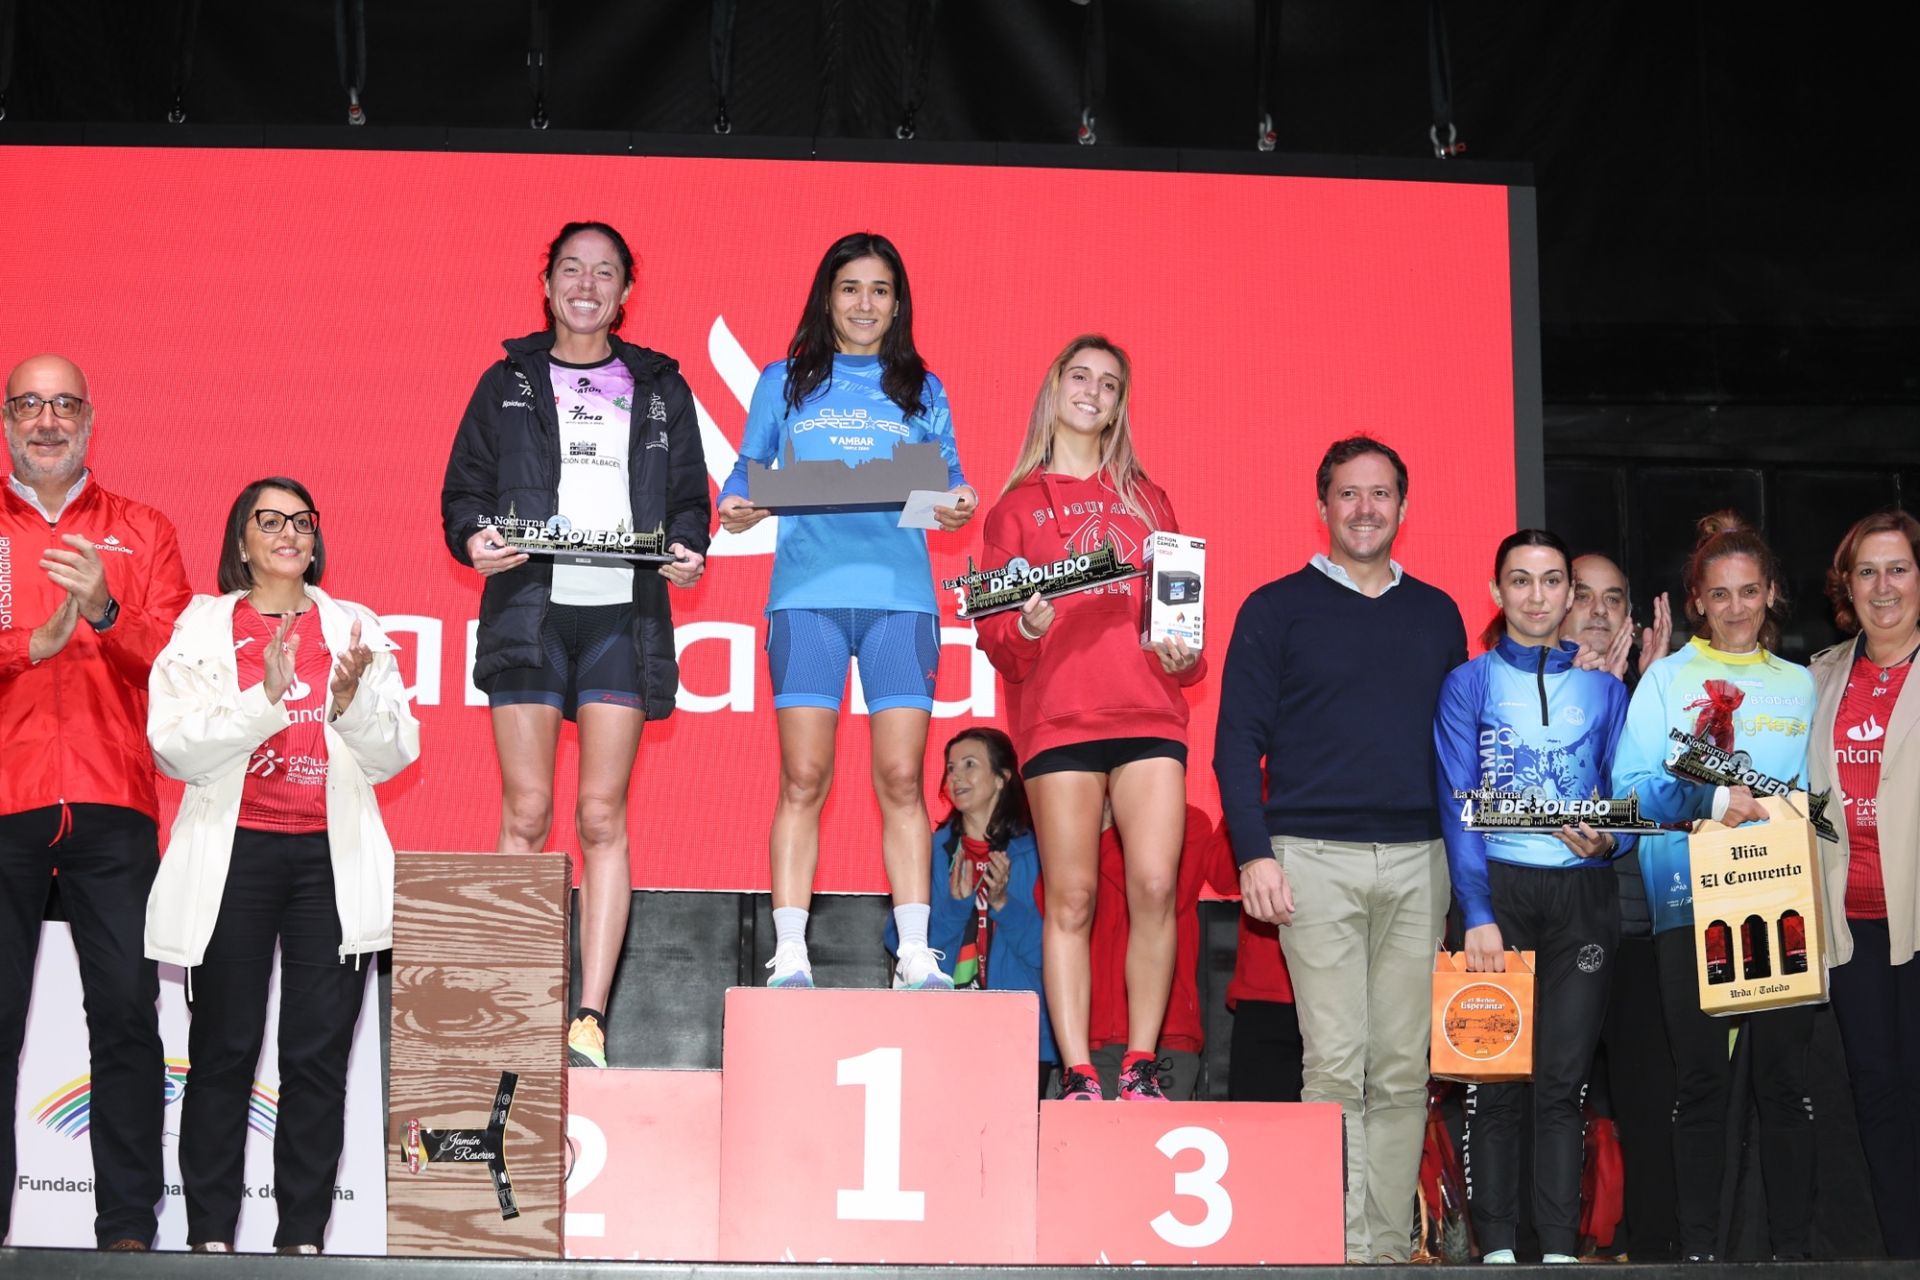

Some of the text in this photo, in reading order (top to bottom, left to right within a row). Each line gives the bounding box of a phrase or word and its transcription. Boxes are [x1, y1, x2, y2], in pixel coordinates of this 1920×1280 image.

[820, 408, 867, 419] CLUB
[838, 436, 875, 446] AMBAR
[477, 514, 545, 529] La Nocturna
[524, 528, 550, 542] DE
[1157, 535, 1177, 543] ACTION
[92, 542, 134, 555] antander
[1156, 540, 1179, 549] CAMERA
[943, 567, 1007, 590] La Nocturna
[990, 576, 1013, 593] DE
[953, 587, 968, 616] 3
[1670, 729, 1730, 761] La Nocturna
[1665, 740, 1685, 767] 5
[287, 765, 301, 773] LA
[1703, 756, 1731, 776] DE
[1454, 789, 1521, 800] La Nocturna
[1460, 800, 1474, 826] 4
[1500, 801, 1526, 814] DE
[1856, 807, 1869, 816] LA
[1730, 845, 1768, 860] Viña
[1700, 873, 1719, 888] El
[1724, 864, 1802, 885] Convento
[1759, 984, 1790, 995] Toledo
[440, 1131, 481, 1151] Jamón
[836, 1047, 926, 1222] 1
[453, 1146, 496, 1160] Reserva
[565, 1114, 608, 1238] 2
[18, 1176, 95, 1194] Fundaci
[1149, 1126, 1233, 1249] 3
